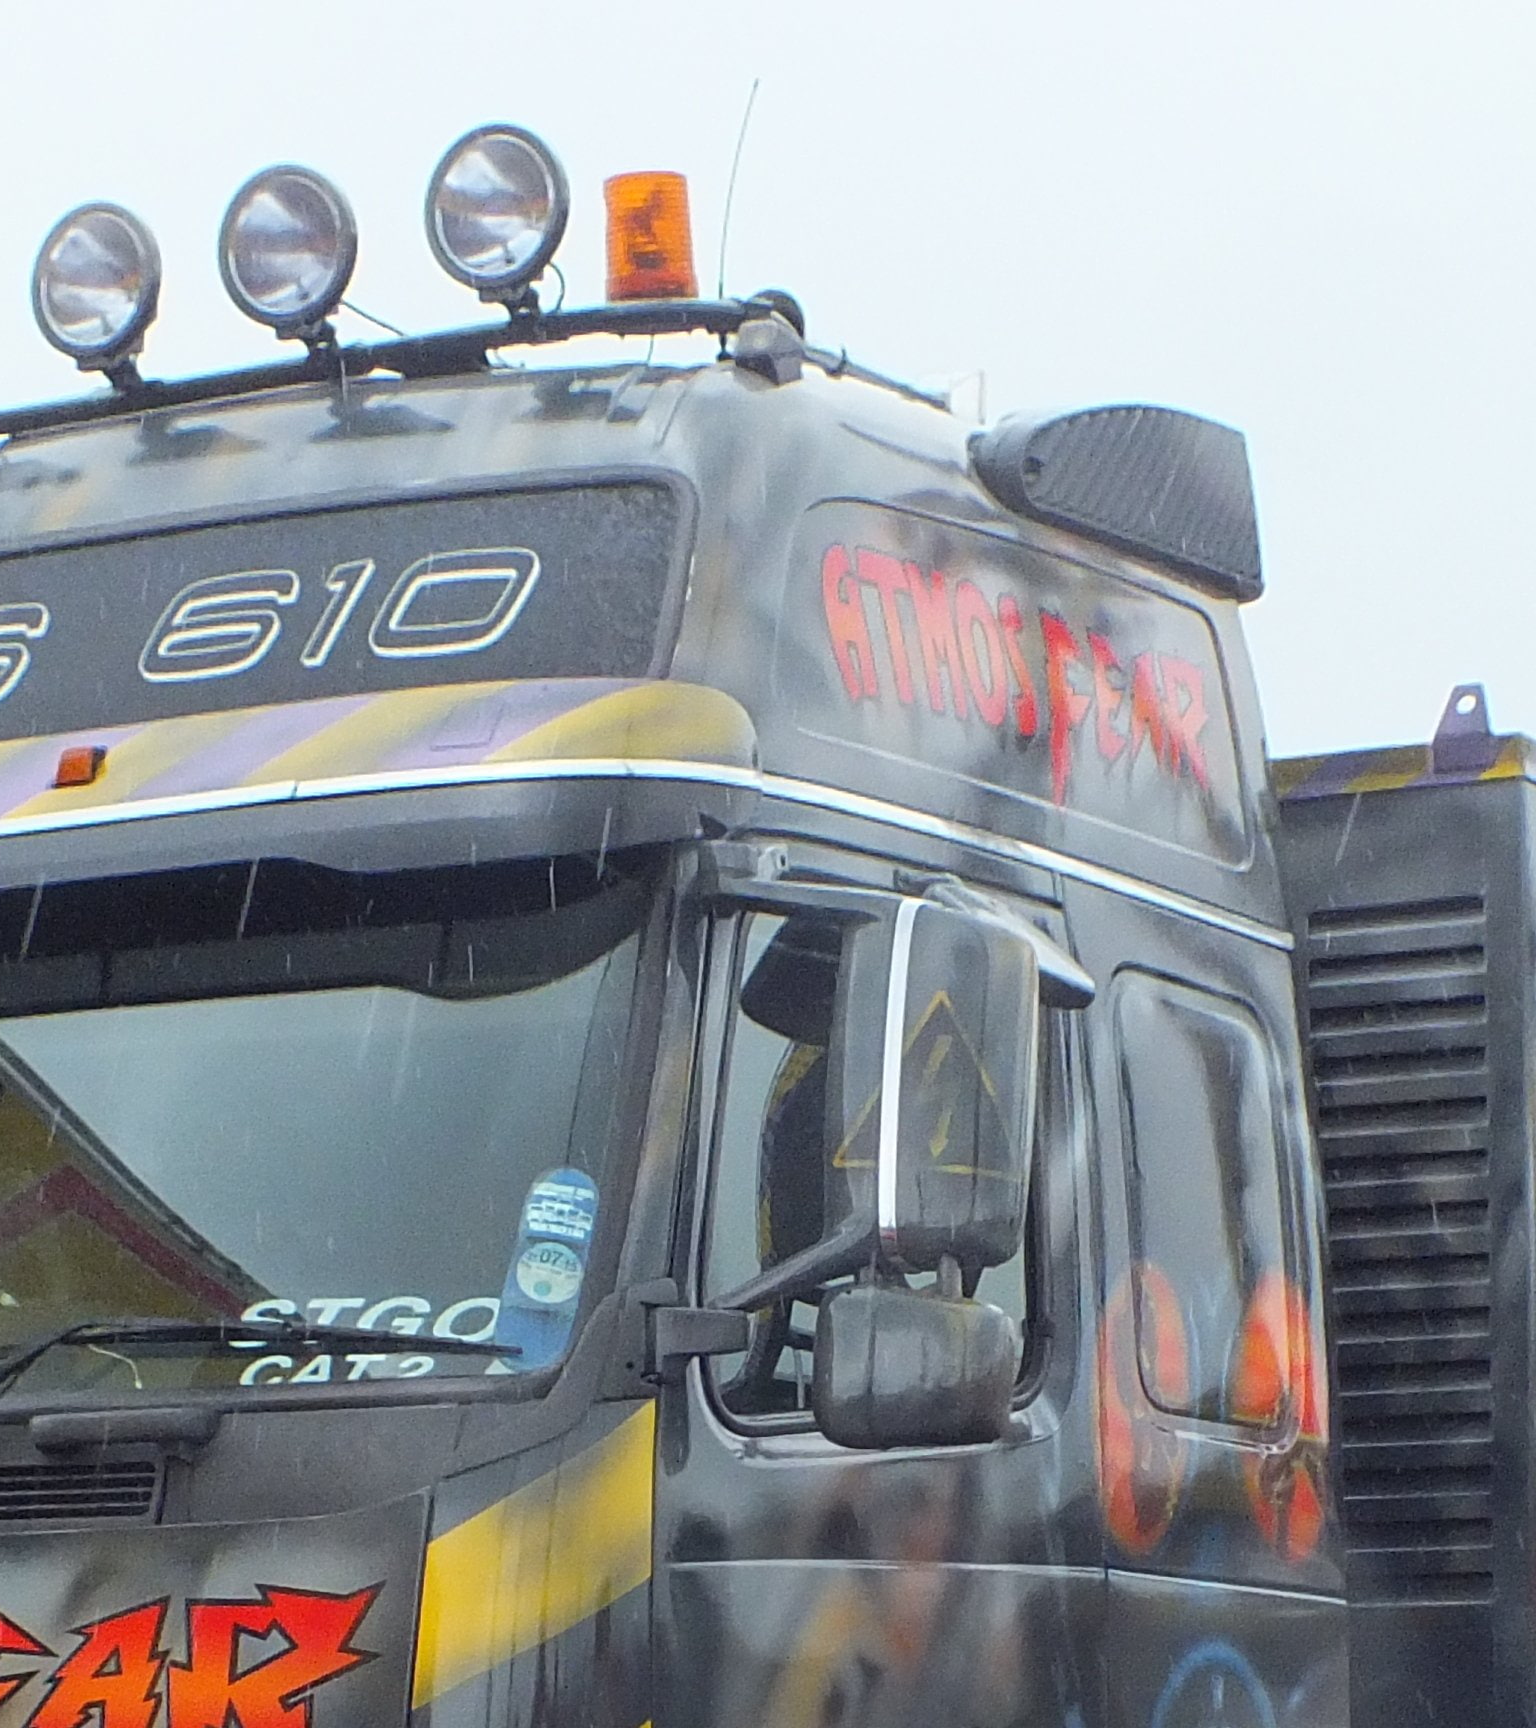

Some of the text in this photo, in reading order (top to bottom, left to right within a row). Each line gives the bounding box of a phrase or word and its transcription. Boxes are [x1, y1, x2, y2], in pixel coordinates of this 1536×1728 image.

[138, 545, 542, 685] 610
[821, 543, 1210, 809] ATMOS FEAR
[228, 1296, 501, 1347] STGO
[239, 1353, 388, 1386] CAT
